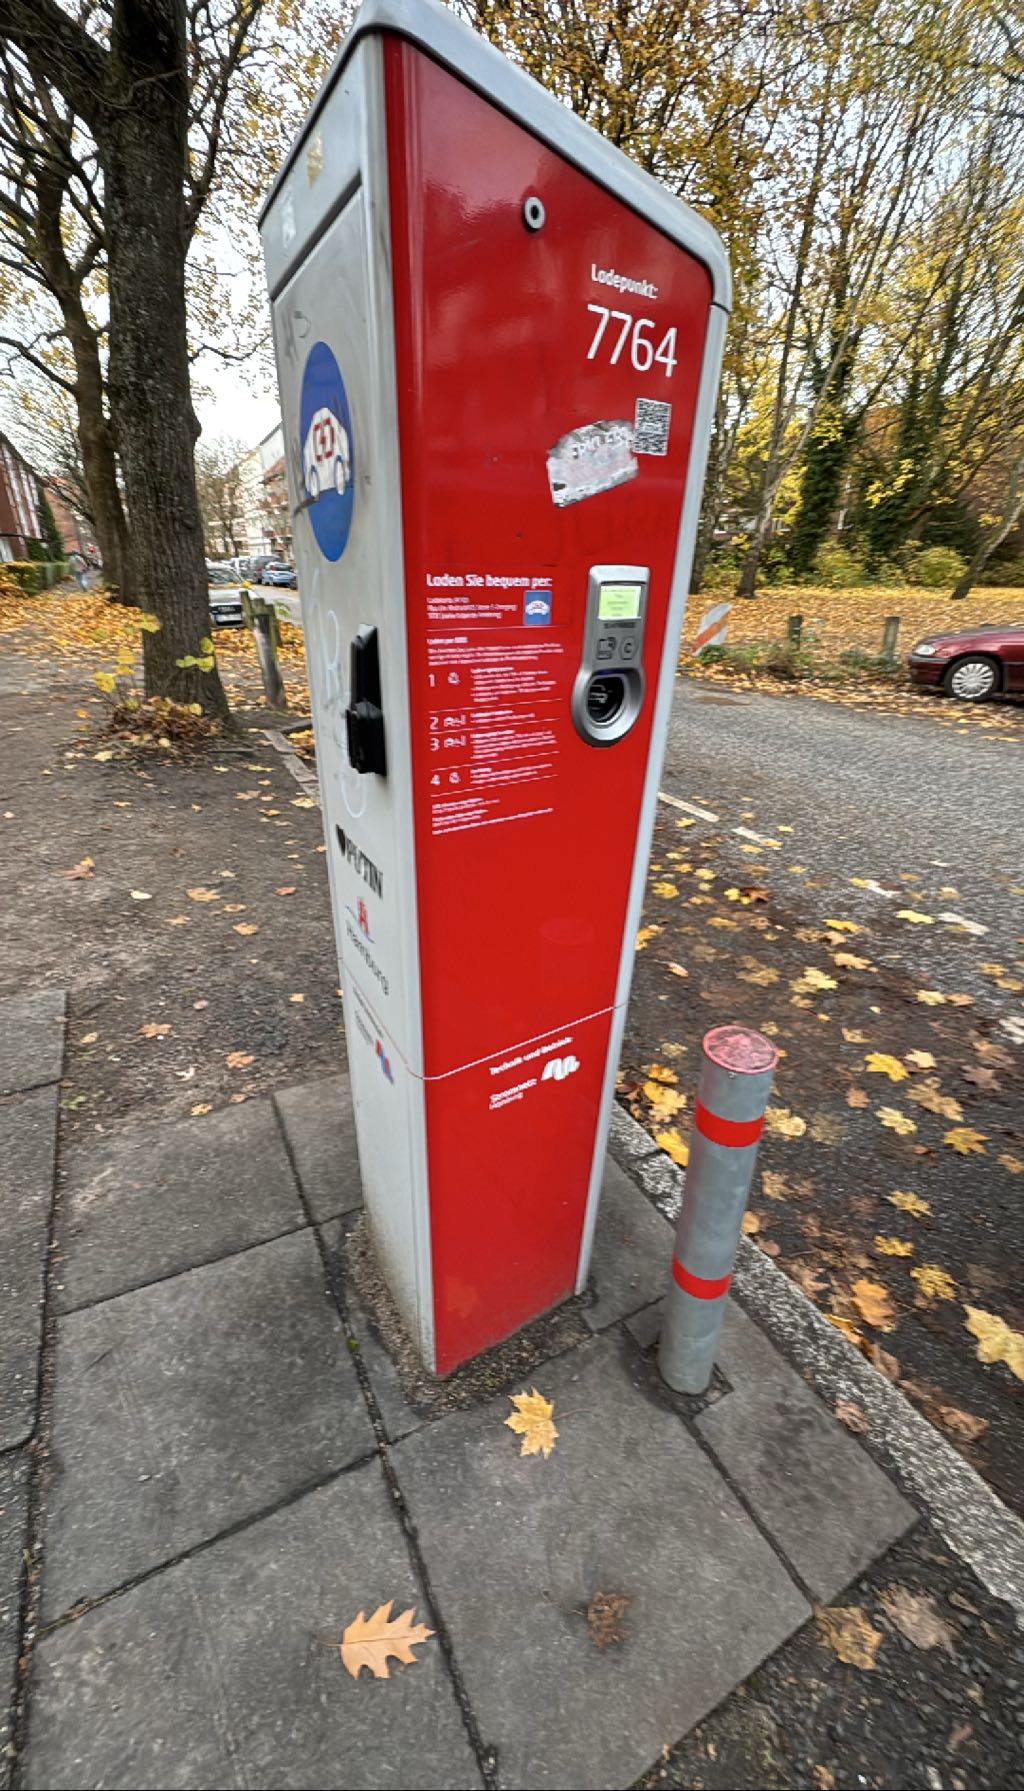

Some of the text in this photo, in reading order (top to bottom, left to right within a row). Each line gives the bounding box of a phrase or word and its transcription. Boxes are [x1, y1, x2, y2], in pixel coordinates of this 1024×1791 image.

[587, 303, 678, 378] 7764
[426, 573, 464, 587] Laden
[465, 574, 484, 587] Sie
[485, 574, 530, 589] bequem
[429, 673, 436, 687] 1
[429, 716, 439, 730] 2
[430, 737, 440, 752] 3
[430, 774, 441, 786] 4
